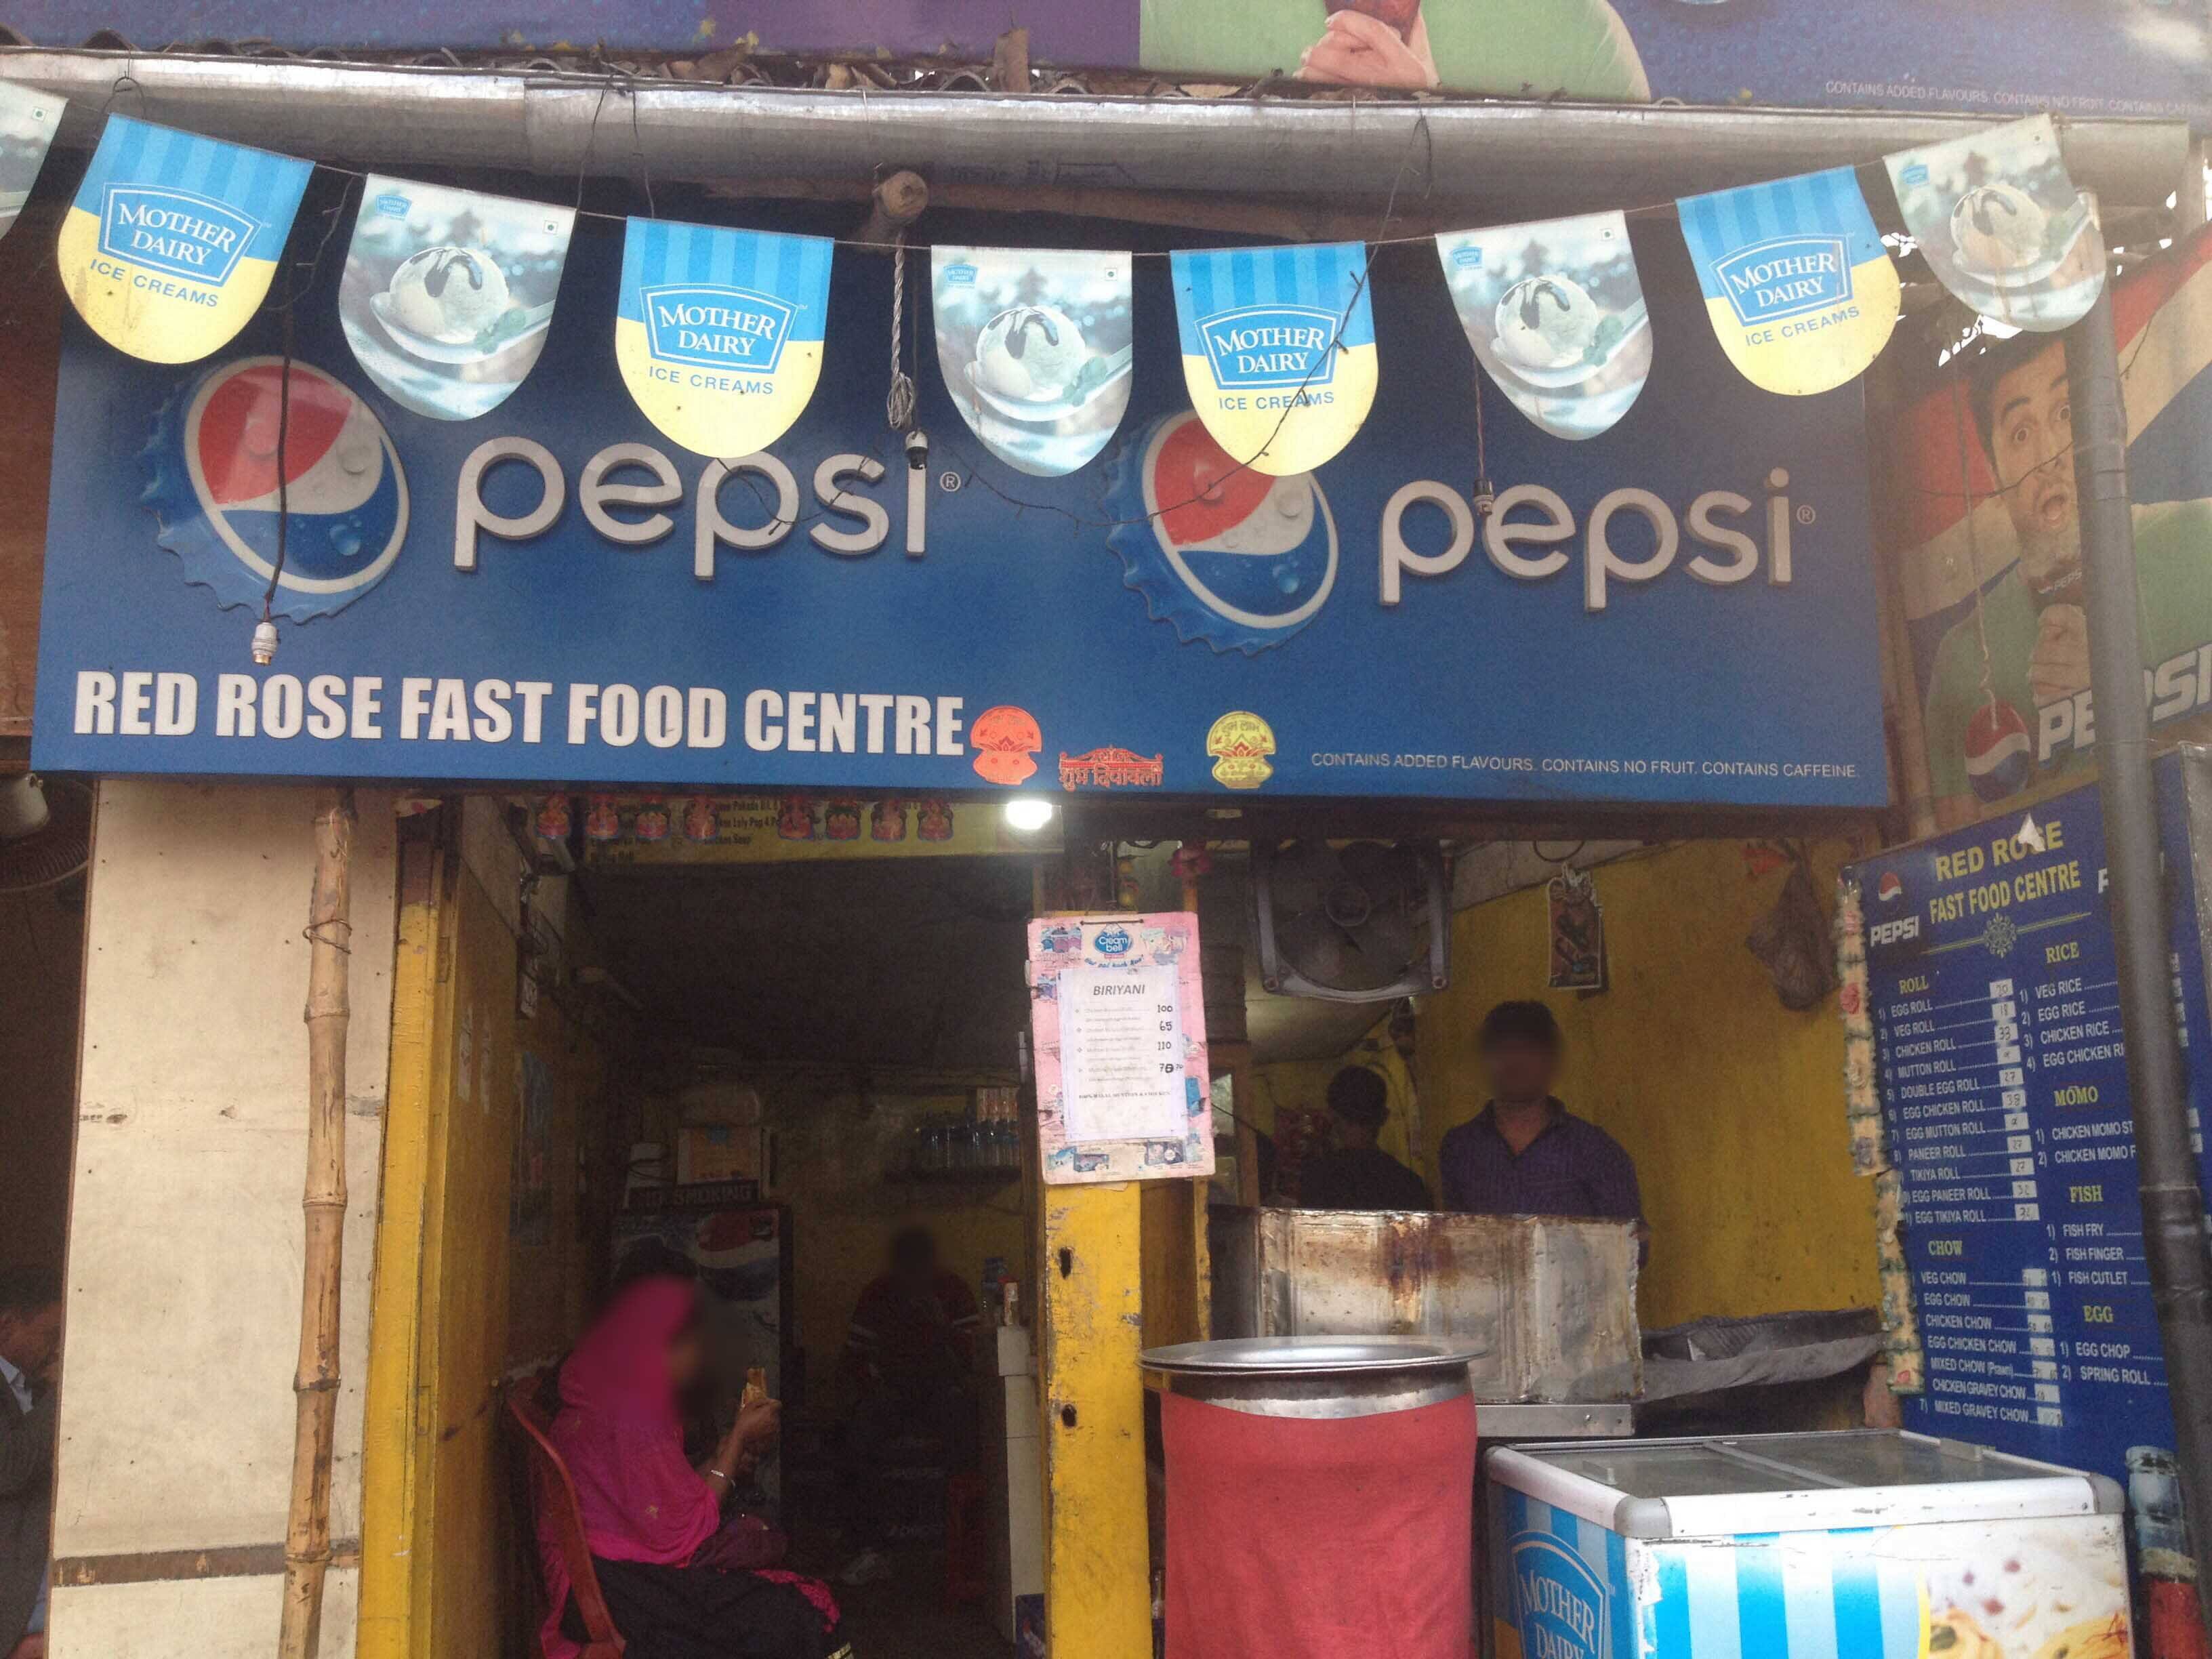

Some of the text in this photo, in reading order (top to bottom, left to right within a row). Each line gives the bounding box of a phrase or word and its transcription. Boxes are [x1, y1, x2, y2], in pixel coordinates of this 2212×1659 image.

[1826, 80, 1885, 97] CONTAINS
[1887, 84, 1927, 100] ADDED
[117, 203, 237, 253] MOTHER
[134, 230, 211, 267] DAIRY
[89, 259, 219, 308] ICE CREAMS
[1730, 253, 1836, 295] MOTHER
[1757, 279, 1826, 308] DAIRY
[658, 304, 776, 340] MOTHER
[1745, 306, 1861, 348] ICE CREAMS
[678, 331, 756, 357] DAIRY
[1213, 325, 1324, 356] MOTHER
[1237, 352, 1309, 374] DAIRY
[649, 366, 774, 395] ICE CREAMS
[1218, 391, 1334, 411] ICE CREAMS
[453, 435, 928, 581] pepsi
[1379, 468, 1793, 613] pepsi
[73, 671, 965, 756] RED ROSE FAST FOOD CENTRE
[2037, 644, 2212, 762] PESI
[1311, 753, 1391, 769] CONTAINS
[1394, 754, 1448, 769] ADDED
[1542, 758, 1620, 773] CONTAINS
[1623, 759, 1647, 774] NO
[1702, 762, 1778, 777] CONTAINS
[1936, 846, 1984, 881] RED
[1929, 892, 1964, 924] FAST
[1969, 880, 2011, 915] FOOD
[2014, 860, 2082, 903] CENTRE
[1099, 935, 1128, 945] Cream
[1870, 916, 1920, 947] PEPSI
[1106, 942, 1124, 952] bell
[2045, 941, 2081, 964] RICE
[1093, 984, 1146, 996] BIRIYANI
[1899, 975, 1930, 995] ROLL
[2020, 977, 2083, 1004] 1) VEG RICE
[1157, 1004, 1174, 1014] 100
[1891, 1004, 1909, 1017] EGG
[1909, 1000, 1933, 1015] ROLL
[2021, 1000, 2086, 1027] 2) EGG RICE
[1159, 1021, 1173, 1031] 65
[1893, 1024, 1912, 1038] VEG
[1912, 1019, 1936, 1034] ROLL
[2024, 1020, 2110, 1049] 3) CHICKEN RICE
[1157, 1041, 1172, 1051] 110
[1895, 1041, 1931, 1059] CHICKEN
[1933, 1038, 1957, 1052] ROLL
[2026, 1044, 2112, 1071] 4) EGG CHICKEN
[1897, 1059, 1957, 1079] MUTTON ROLL
[1901, 1084, 1936, 1099] DOUBLE
[1936, 1081, 1956, 1095] EGG
[1957, 1078, 1980, 1092] ROLL
[2053, 1085, 2100, 1107] MOMO
[1903, 1099, 1986, 1120] EGG CHICKEN ROLL
[1906, 1121, 1986, 1140] EGG MUTTON ROLL
[2035, 1122, 2121, 1145] 1) CHICKEN MOMO
[1908, 1144, 1965, 1161] PANEER ROLL
[2038, 1151, 2047, 1168] 2)
[2055, 1147, 2096, 1164] CHICKEN
[2097, 1145, 2128, 1161] MOMO
[1910, 1166, 1961, 1182] TIKIYA ROLL
[1912, 1190, 1931, 1204] EGG
[1931, 1188, 1966, 1202] PANEER
[1967, 1187, 1991, 1200] ROLL
[2070, 1184, 2104, 1203] FISH
[1914, 1211, 1933, 1224] EGG
[1935, 1210, 1962, 1223] TIKIYA
[1963, 1209, 1986, 1223] ROLL
[2046, 1223, 2104, 1241] 1) FISH FRY
[1928, 1240, 1963, 1256] CHOW
[2048, 1246, 2125, 1264] 2) FISH FINGER
[1921, 1271, 1967, 1286] VEG CHOW
[2068, 1271, 2091, 1286] FISH
[2091, 1271, 2128, 1286] CUTLET
[1923, 1292, 1971, 1307] EGG CHOW
[1925, 1313, 1992, 1330] CHICKEN CHOW
[2083, 1305, 2114, 1324] EGG
[1927, 1335, 1947, 1349] EGG
[1947, 1336, 1988, 1352] CHICKEN
[1988, 1338, 2018, 1353] CHOW
[2060, 1340, 2070, 1358] 1)
[2075, 1341, 2100, 1357] EGG
[2100, 1343, 2131, 1359] CHOP
[1930, 1357, 1957, 1371] MIXED
[1958, 1359, 1986, 1374] CHOW
[2062, 1364, 2072, 1381] 2)
[2080, 1365, 2121, 1383] SPRING
[2122, 1368, 2152, 1386] ROLL
[1932, 1377, 1967, 1394] CHICKEN
[1967, 1380, 2001, 1397] GRAVEY
[2001, 1383, 2027, 1400] CHOW
[1934, 1399, 1962, 1415] MIXED
[1962, 1402, 1999, 1420] GRAVEY
[1999, 1407, 2029, 1423] CHOW
[1519, 1570, 1595, 1655] MOTHER
